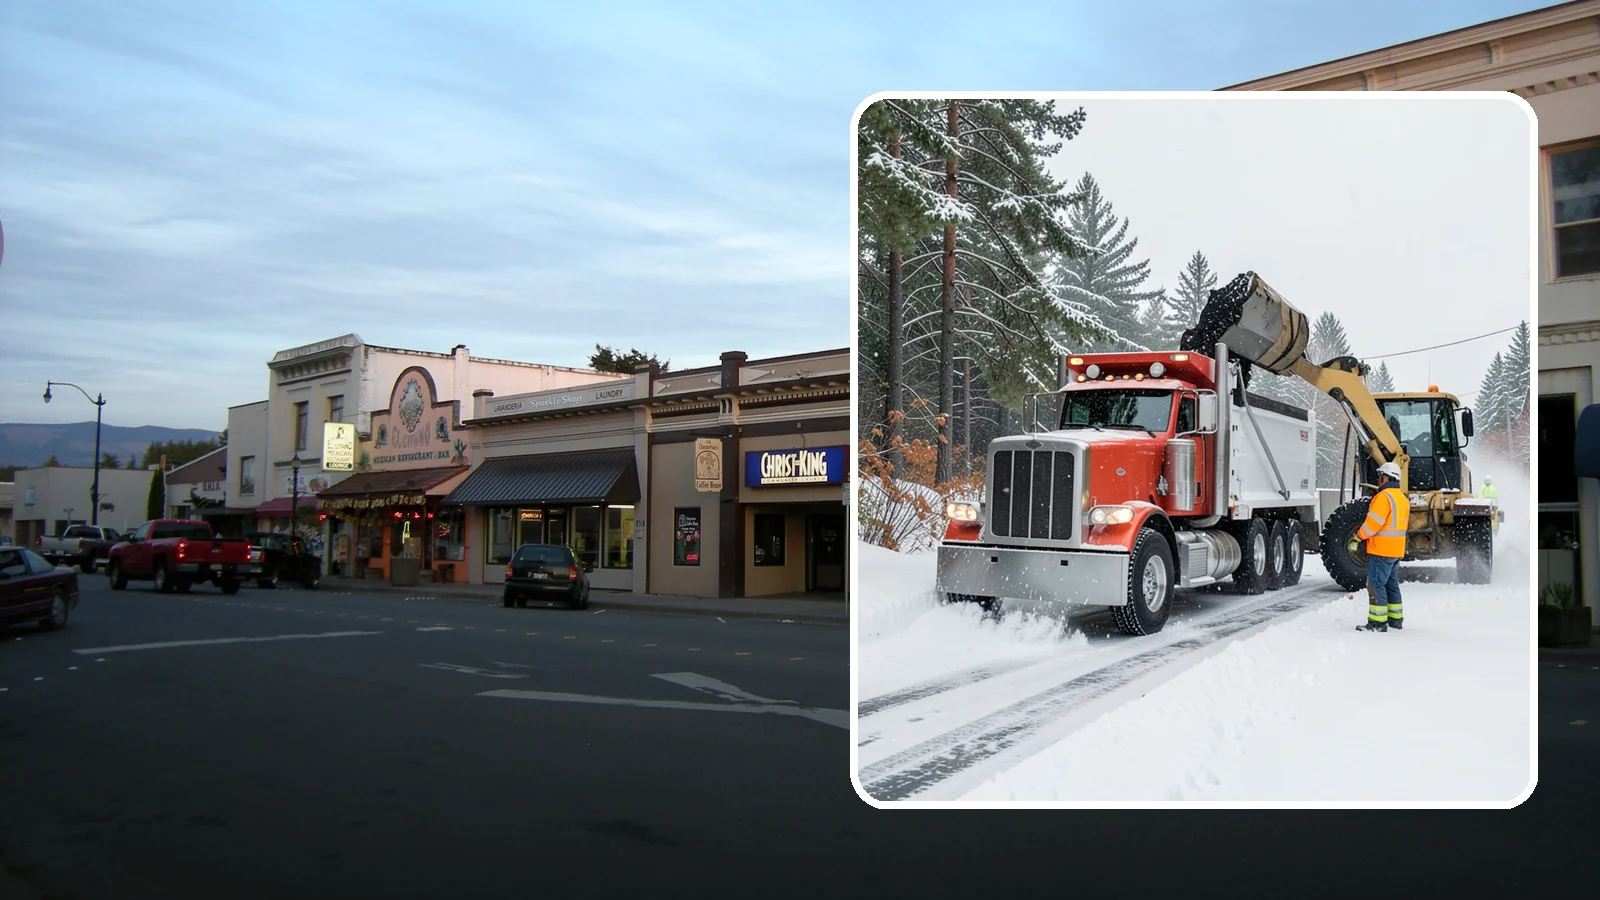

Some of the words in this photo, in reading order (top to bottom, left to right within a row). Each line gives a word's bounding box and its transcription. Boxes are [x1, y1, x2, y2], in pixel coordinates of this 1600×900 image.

[493, 402, 523, 412] LAVANDERIA
[561, 394, 582, 405] Shop
[595, 389, 624, 399] LAUNDRY
[373, 454, 396, 463] MEXICAN
[397, 451, 433, 462] RESTAURANT
[438, 450, 450, 458] BAR
[761, 452, 797, 478] CHRIST
[799, 450, 827, 476] KING
